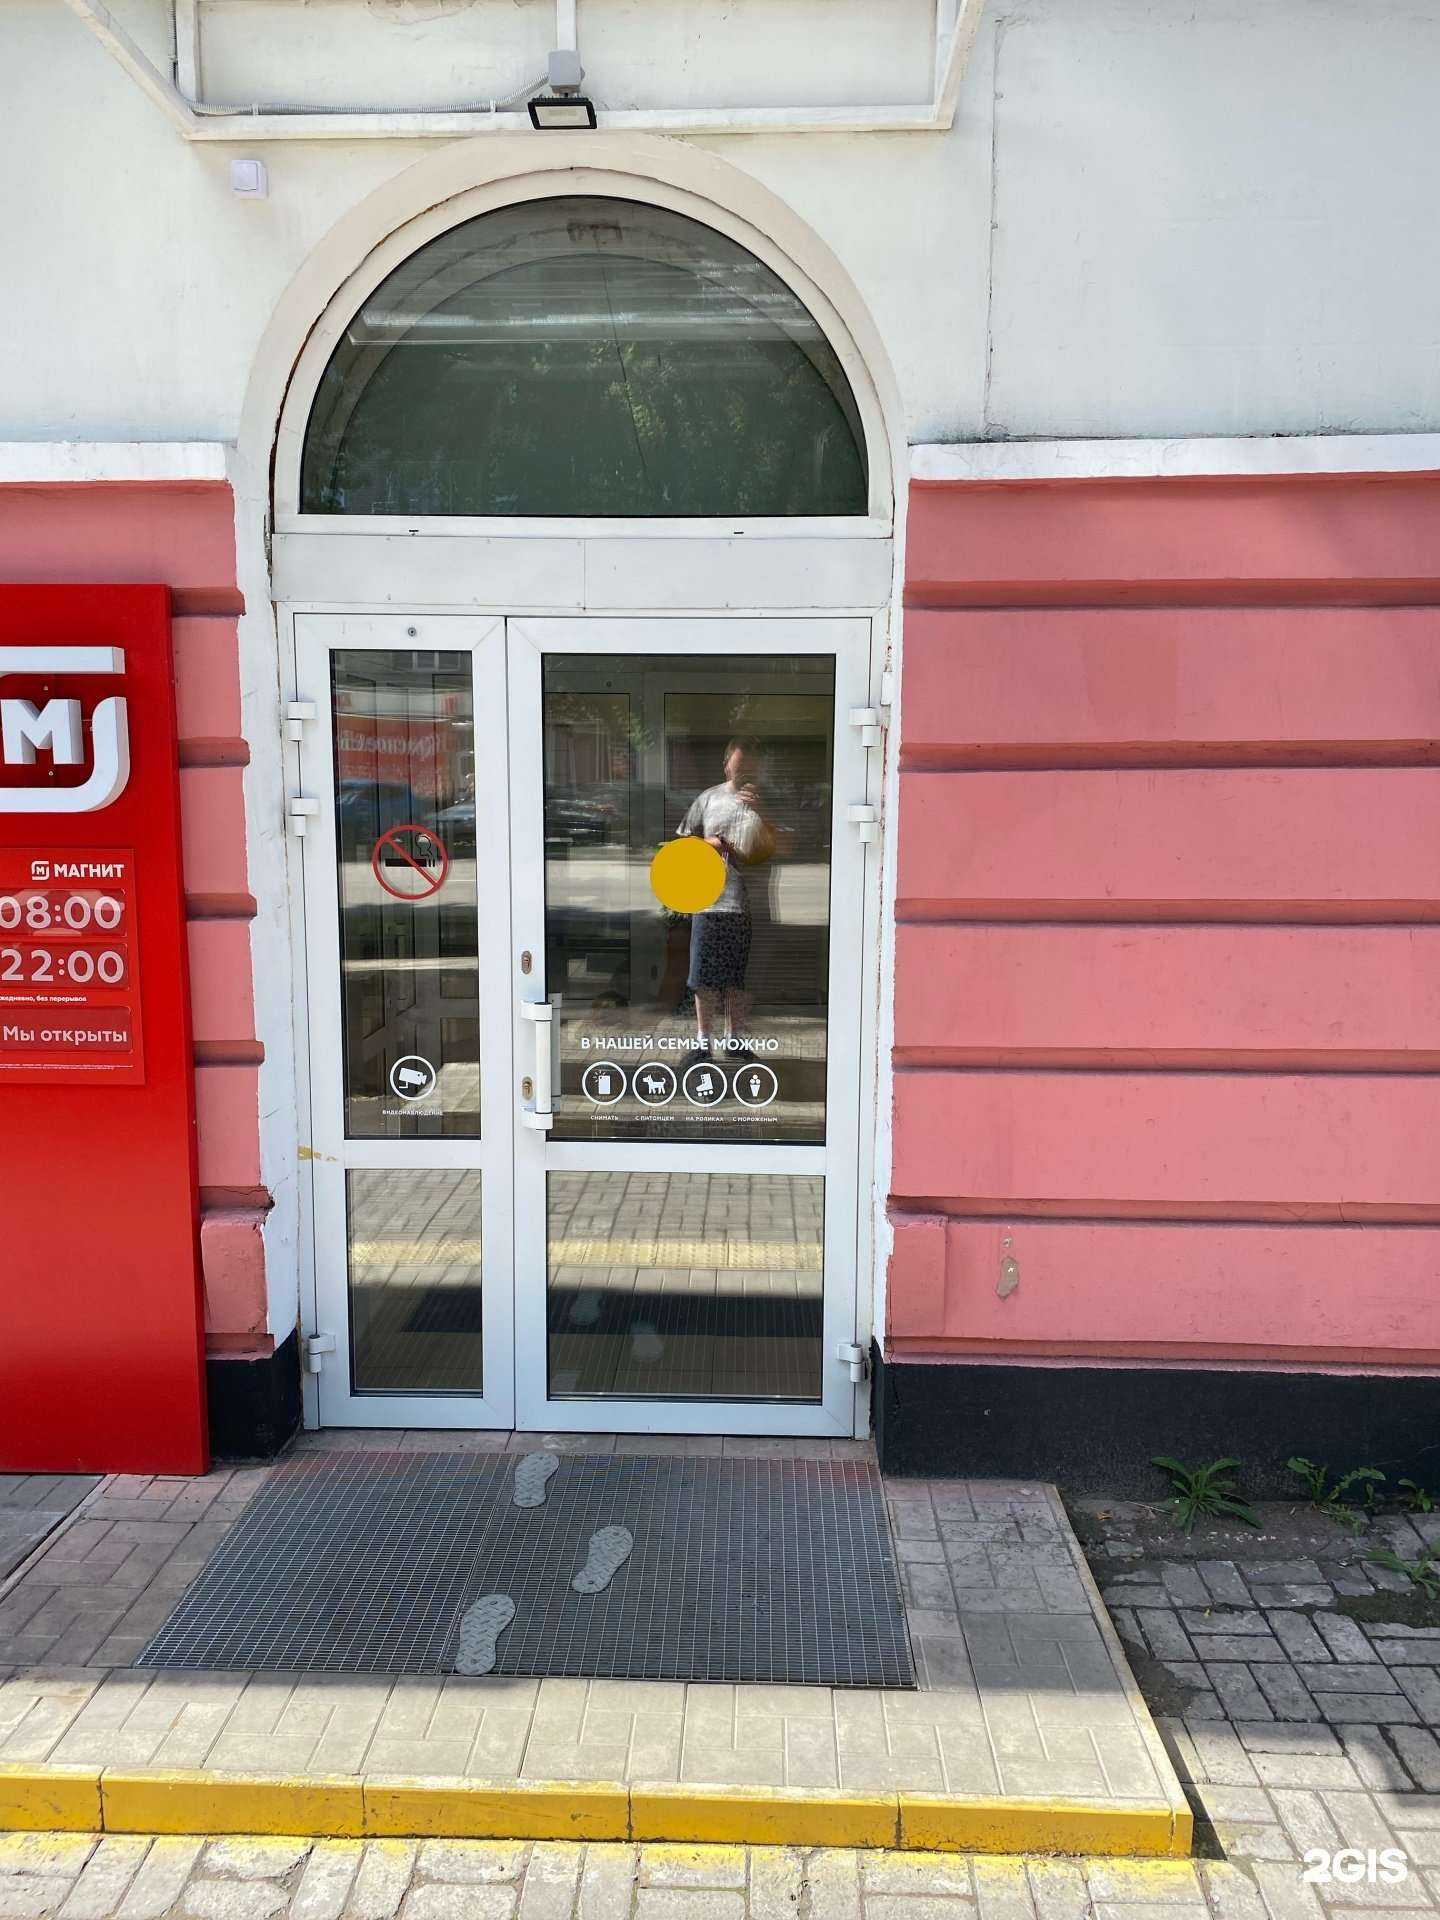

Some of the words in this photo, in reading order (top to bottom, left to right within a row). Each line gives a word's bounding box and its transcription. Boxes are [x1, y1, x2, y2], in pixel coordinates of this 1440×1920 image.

[53, 863, 124, 878] МАГНИТ
[0, 895, 122, 929] 08:00
[1, 948, 124, 983] 22:00
[3, 1026, 35, 1042] Мы
[40, 1029, 127, 1045] открыты
[581, 1038, 591, 1049] В
[595, 1035, 653, 1050] НАШЕЙ
[657, 1038, 708, 1050] СЕМЬЕ
[713, 1038, 779, 1051] МОЖНО
